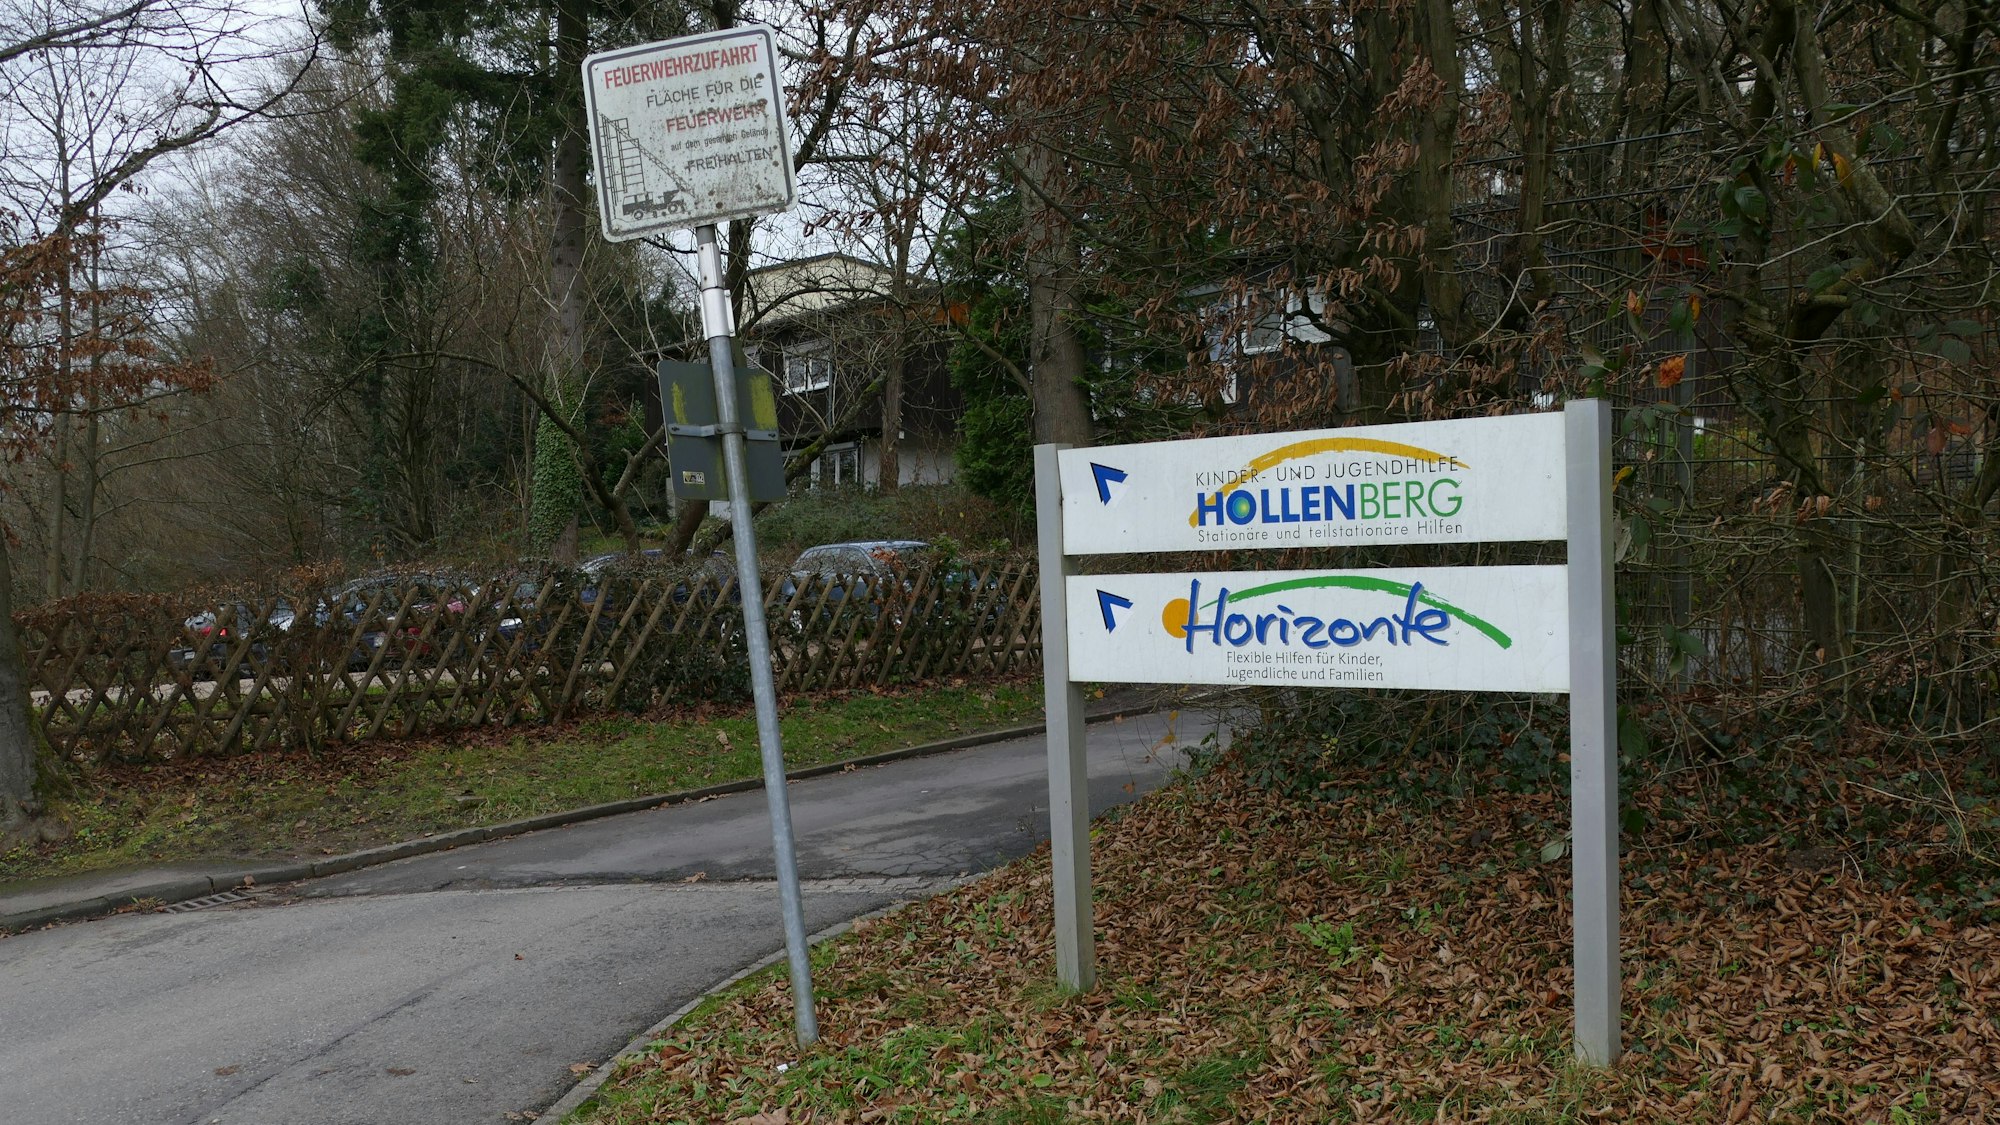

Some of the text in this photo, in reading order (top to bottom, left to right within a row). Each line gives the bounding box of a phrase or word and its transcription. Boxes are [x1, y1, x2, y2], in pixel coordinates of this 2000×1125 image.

[604, 44, 758, 90] FEUERWEHRZUFAHRT
[646, 77, 763, 108] FLÄCHE FÜR DIE
[671, 142, 682, 151] auf
[685, 139, 701, 149] dem
[687, 146, 773, 172] FREIHALTEN
[1195, 456, 1460, 487] KINDER- UND JUGENDHILFE
[1197, 478, 1463, 527] HOLLENBERG
[1198, 520, 1464, 543] Stationäre und teilstationäre Hilfen
[1181, 578, 1450, 654] Horizonte
[1226, 650, 1383, 667] Flexible Hilfen für Kinder,
[1226, 666, 1384, 682] Jugendliche und Familien
